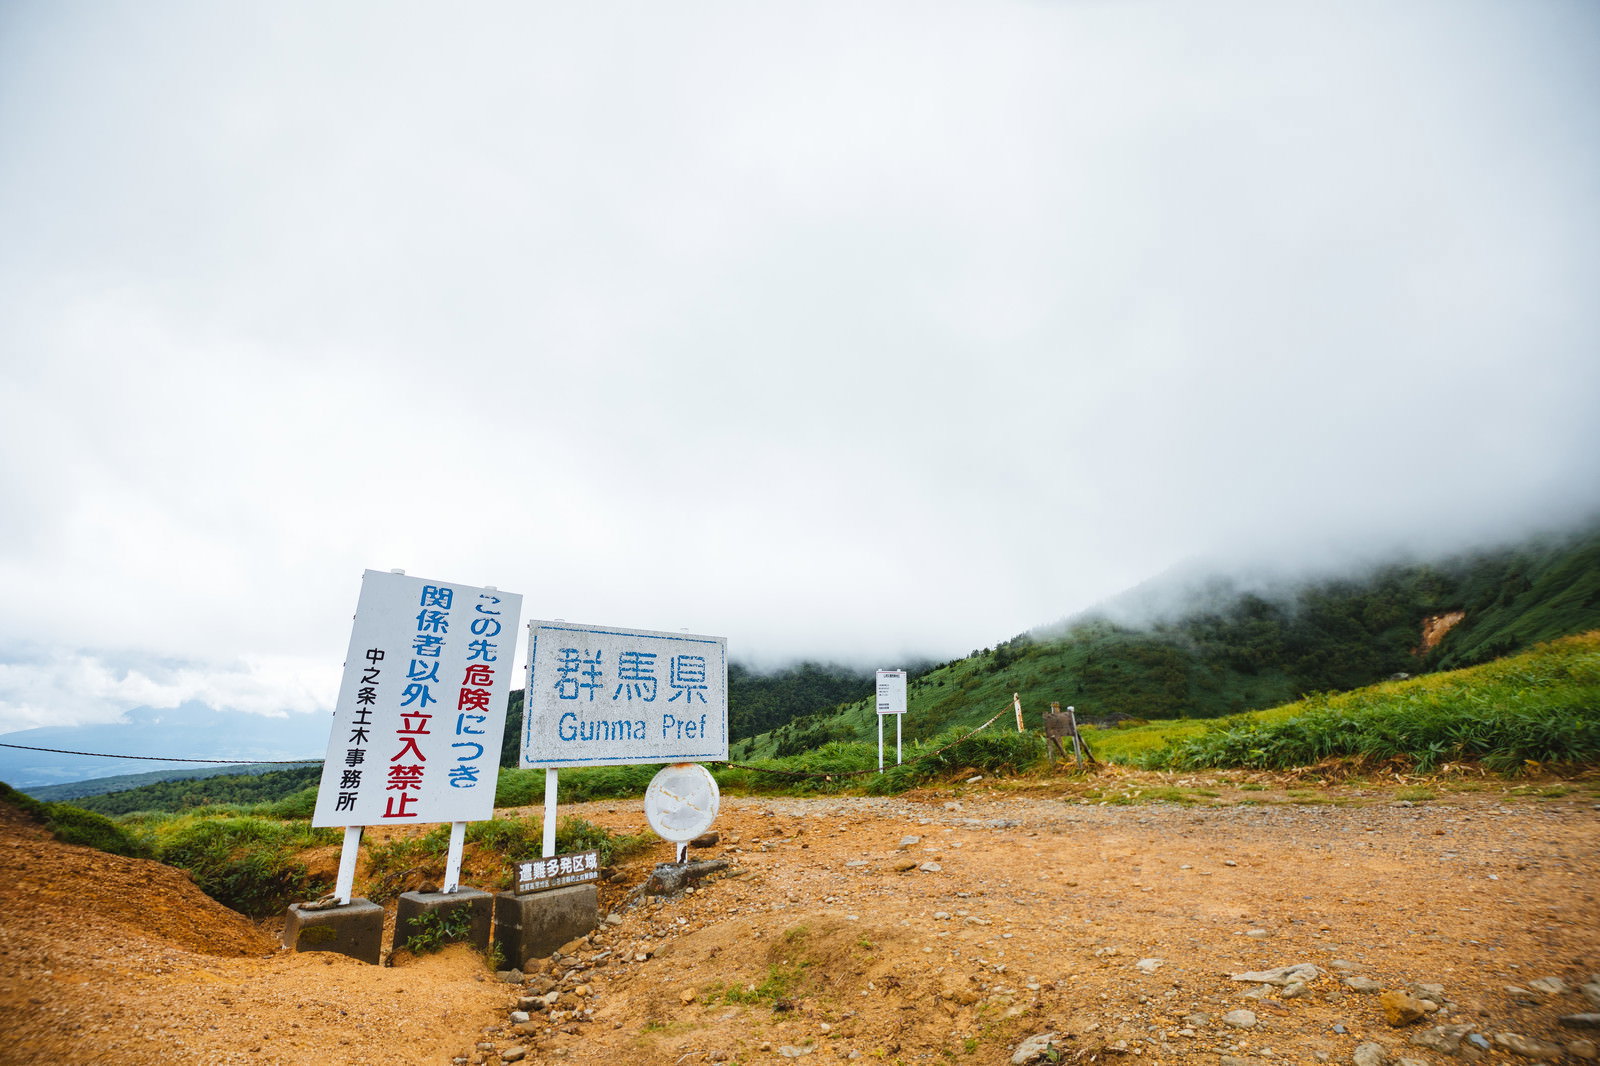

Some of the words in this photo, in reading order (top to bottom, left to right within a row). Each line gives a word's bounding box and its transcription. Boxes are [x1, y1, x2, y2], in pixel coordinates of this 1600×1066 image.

[335, 648, 385, 812] 中之条土木事務所
[382, 585, 453, 818] 関係者以外立入禁止
[448, 594, 502, 789] この先危険につき
[554, 648, 708, 703] 群馬県
[558, 711, 646, 742] Gunma
[662, 713, 707, 740] Pref
[519, 853, 598, 882] 遭難多発区域
